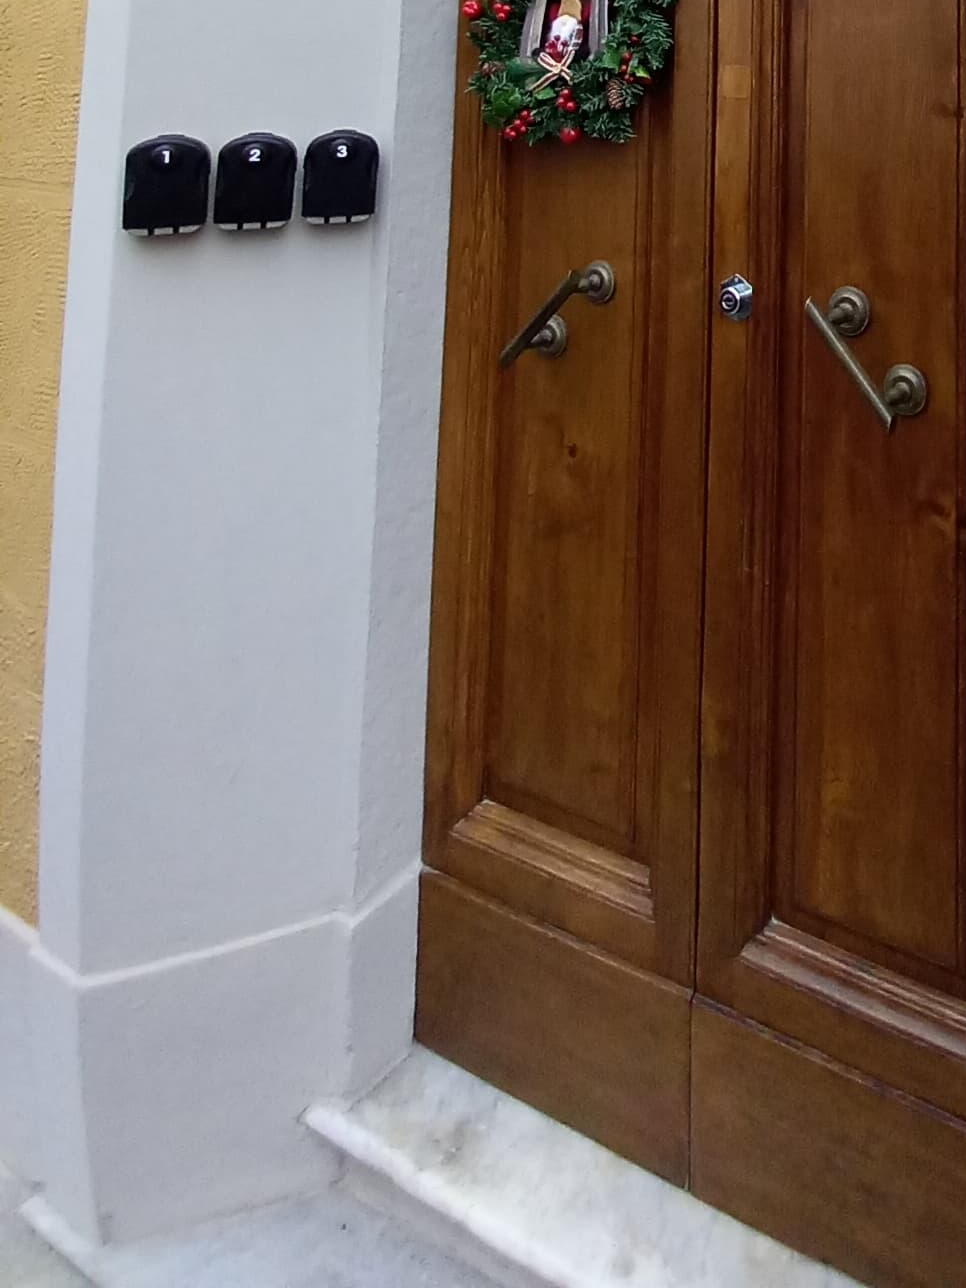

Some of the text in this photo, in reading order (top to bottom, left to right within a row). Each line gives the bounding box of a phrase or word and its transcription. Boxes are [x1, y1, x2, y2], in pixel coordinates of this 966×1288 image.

[162, 150, 170, 163] 1
[249, 148, 261, 162] 2
[336, 145, 348, 158] 3
